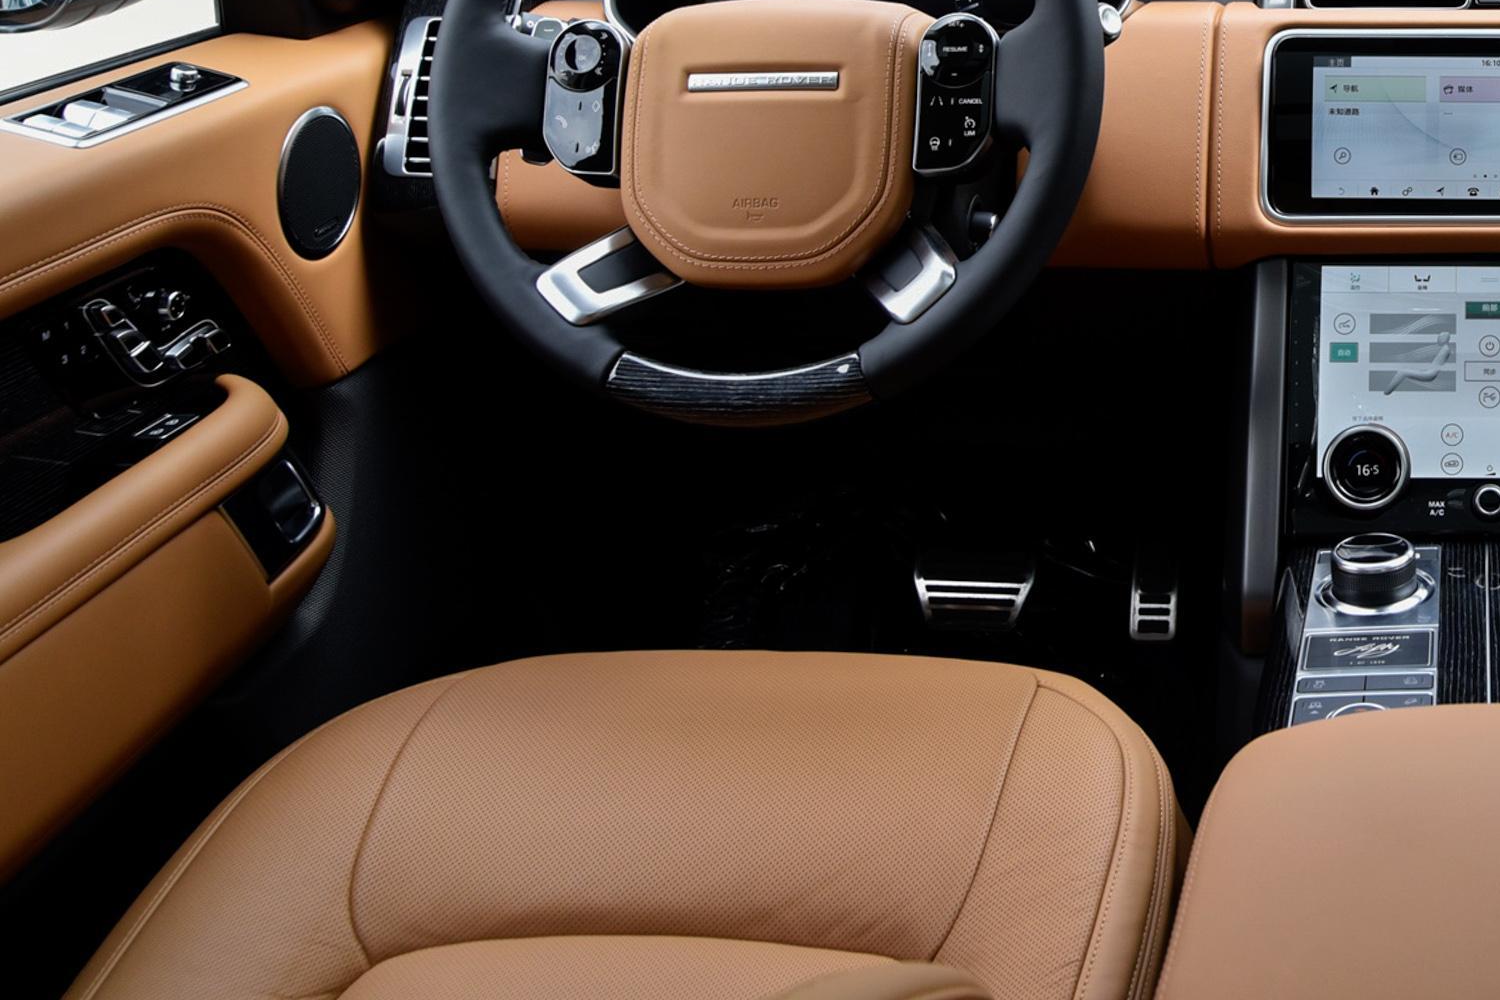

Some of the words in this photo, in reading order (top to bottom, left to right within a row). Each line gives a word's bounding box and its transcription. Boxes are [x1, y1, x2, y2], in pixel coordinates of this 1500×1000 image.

[766, 76, 834, 86] ROVER
[1343, 84, 1359, 93] 导航
[1457, 85, 1474, 93] 媒体
[958, 97, 983, 105] CANCEL
[1328, 107, 1360, 116] 未知道路
[731, 197, 779, 209] AIRBAG
[1445, 431, 1459, 439] A/C
[1429, 509, 1445, 517] A/C
